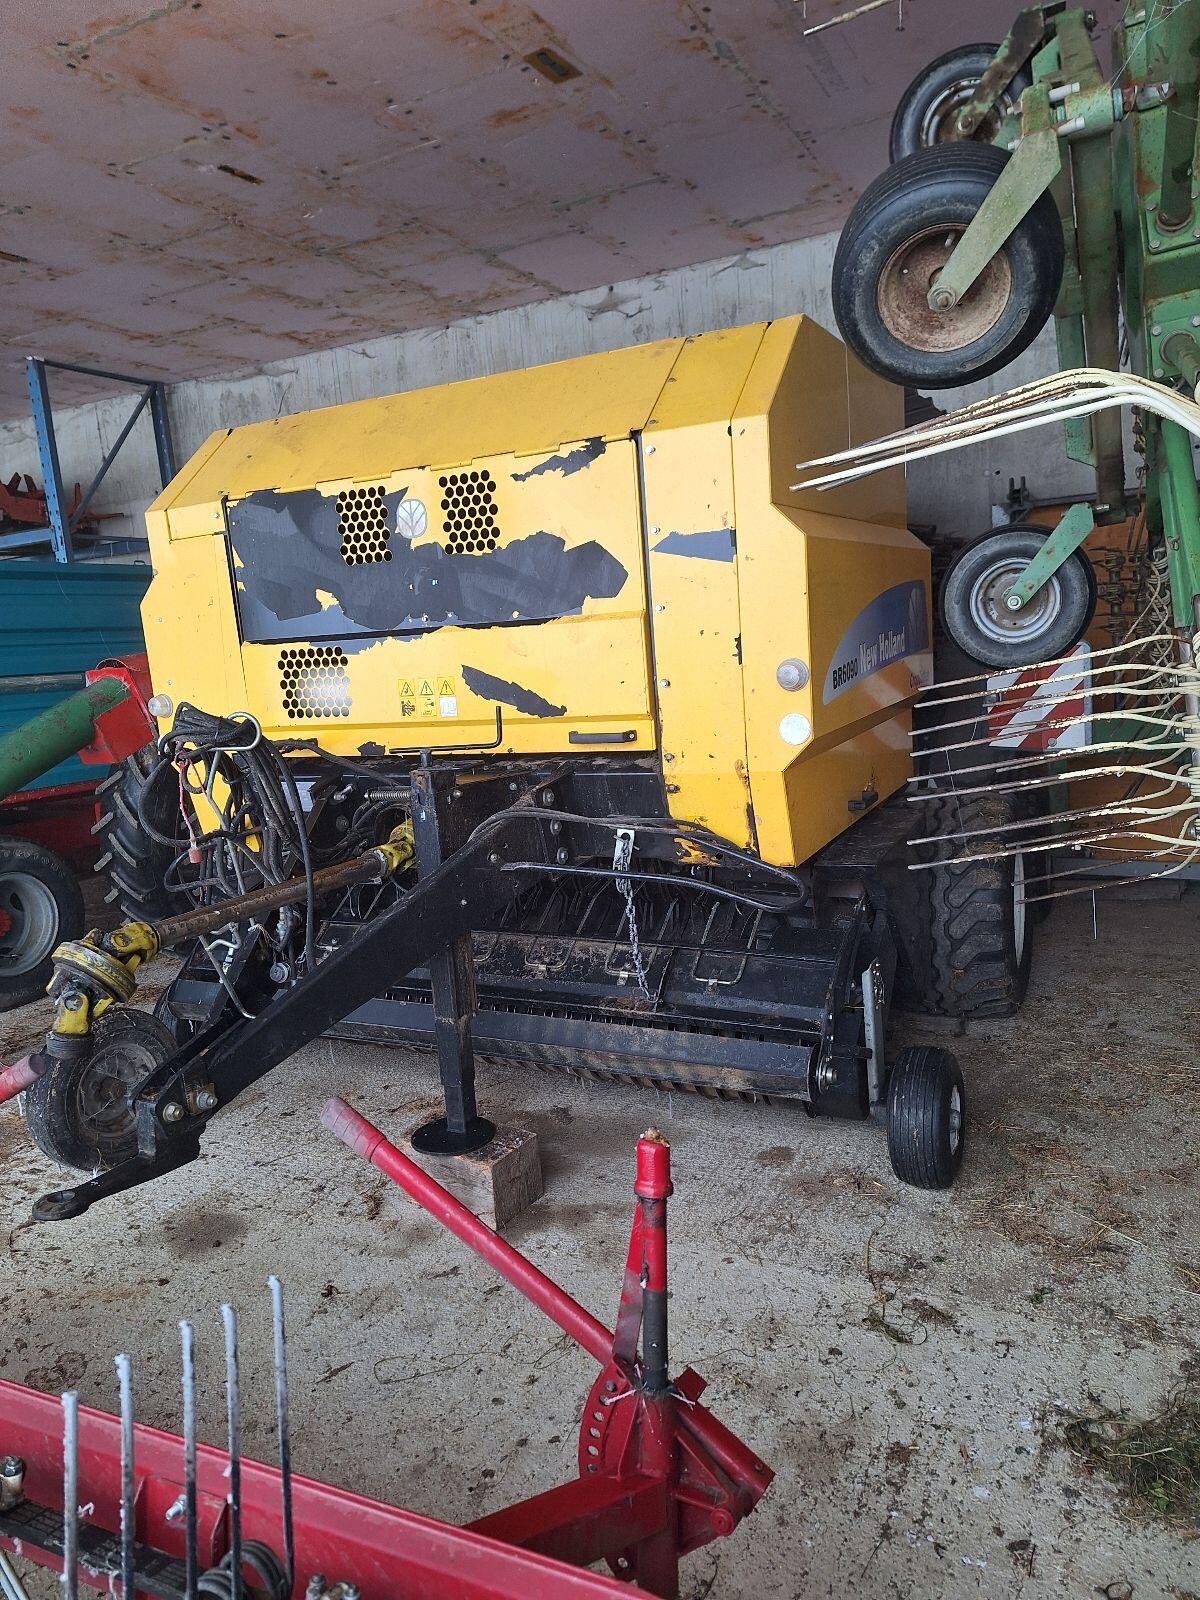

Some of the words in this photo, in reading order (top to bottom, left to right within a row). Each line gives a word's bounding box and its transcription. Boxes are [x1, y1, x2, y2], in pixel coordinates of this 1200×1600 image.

[832, 657, 858, 689] BR6090
[859, 643, 878, 674] New
[879, 626, 905, 662] Holland
